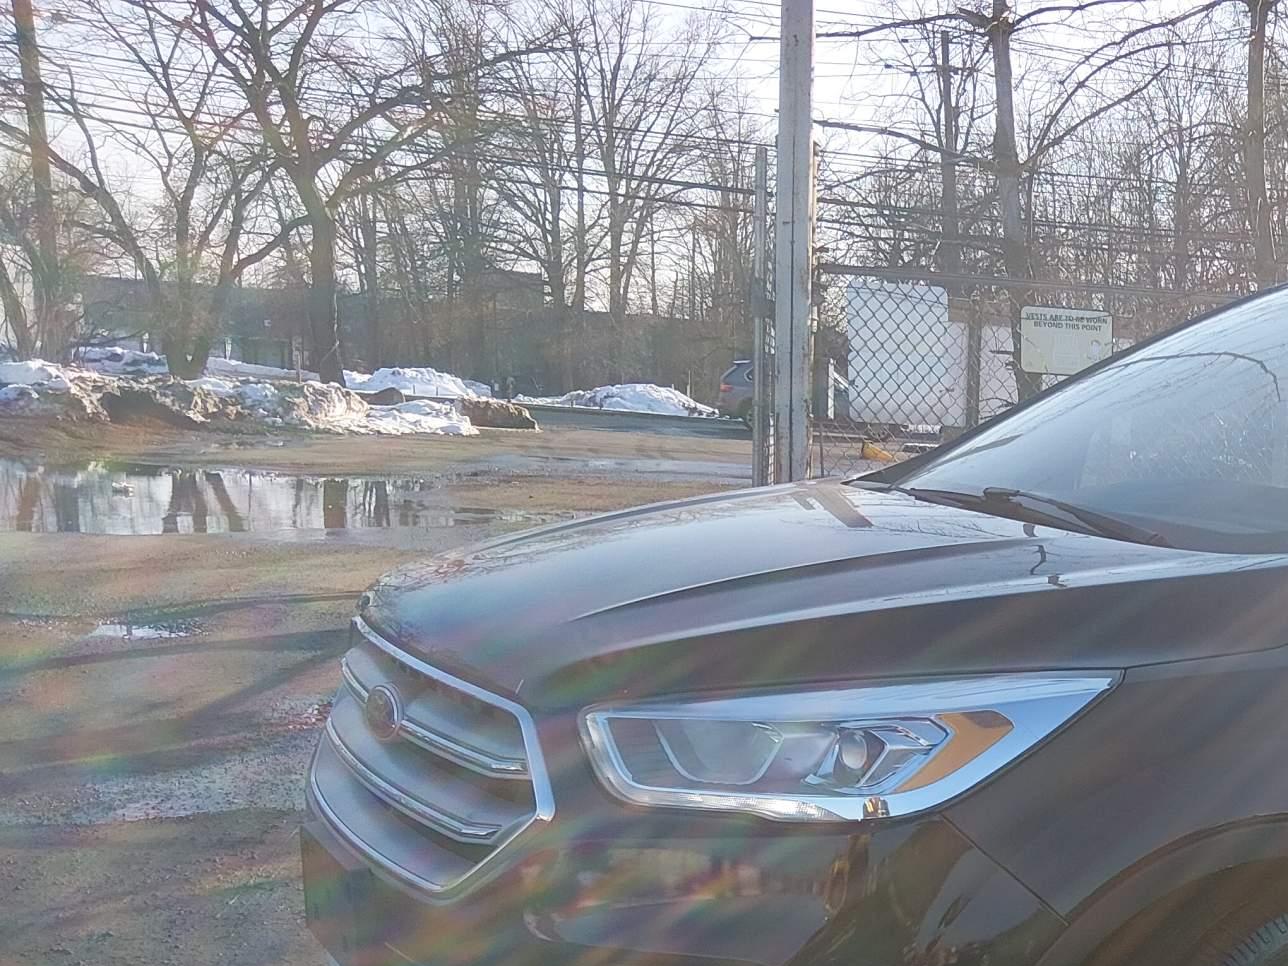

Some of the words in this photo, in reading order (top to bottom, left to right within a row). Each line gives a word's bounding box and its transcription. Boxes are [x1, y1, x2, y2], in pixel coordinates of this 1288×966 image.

[1025, 312, 1048, 320] VESTS
[1033, 320, 1063, 328] BEYOND
[1065, 322, 1080, 330] THIS
